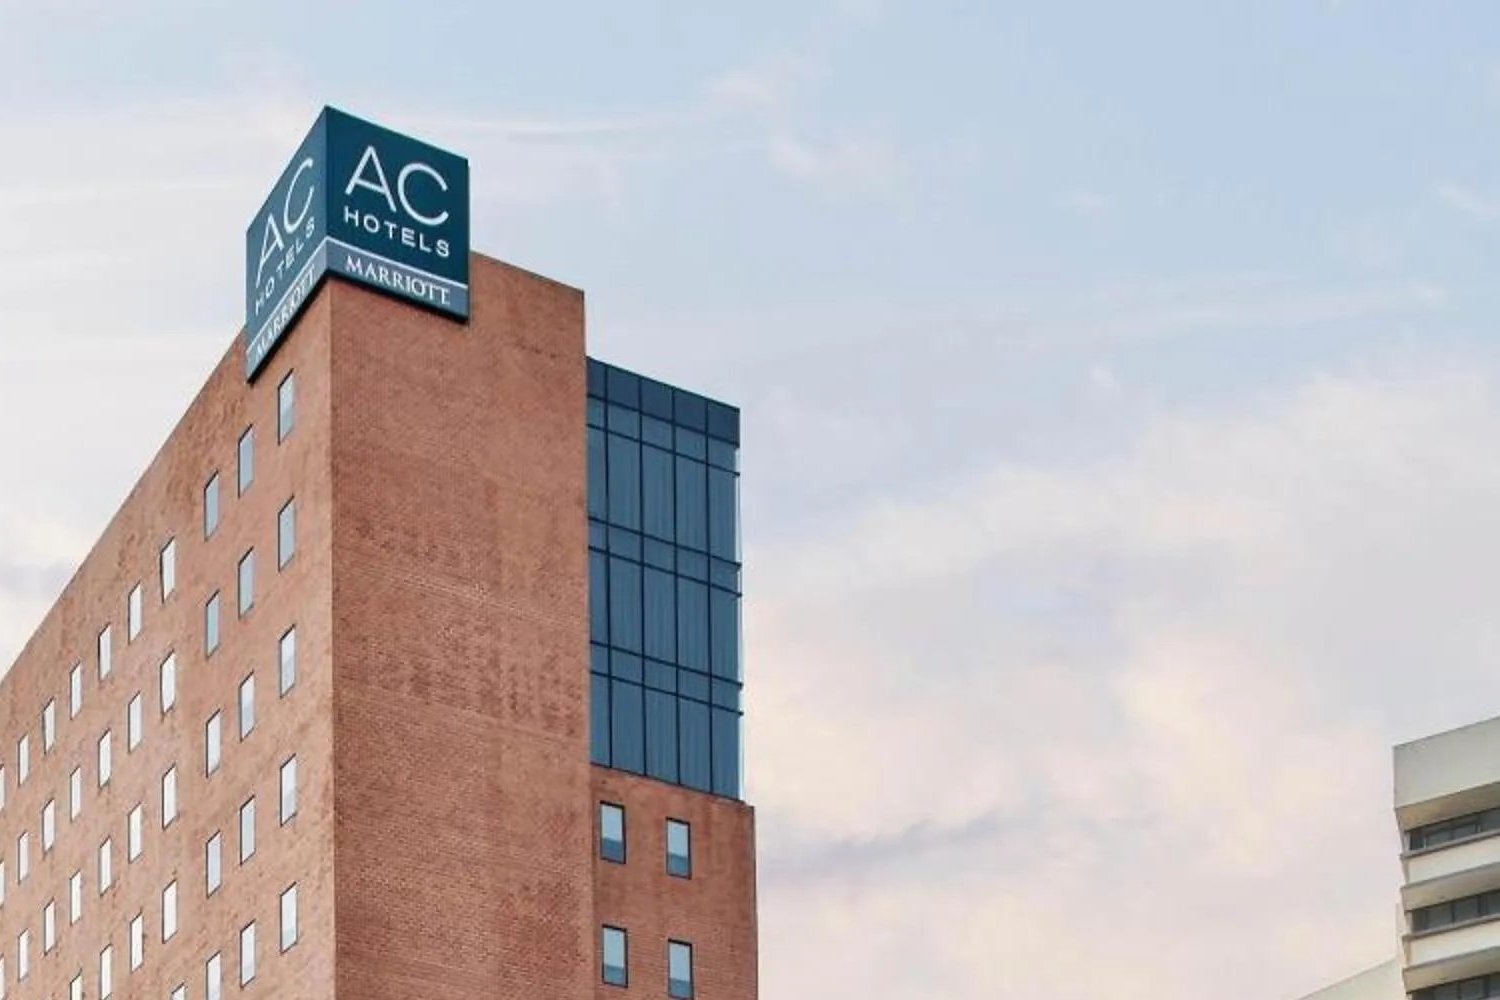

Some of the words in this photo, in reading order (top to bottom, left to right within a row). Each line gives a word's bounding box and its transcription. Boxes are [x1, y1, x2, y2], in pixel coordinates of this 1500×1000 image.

[256, 157, 314, 288] AC
[345, 145, 449, 226] AC
[255, 216, 315, 316] HOTELS
[344, 206, 450, 258] HOTELS
[345, 255, 450, 306] MARRIOTT
